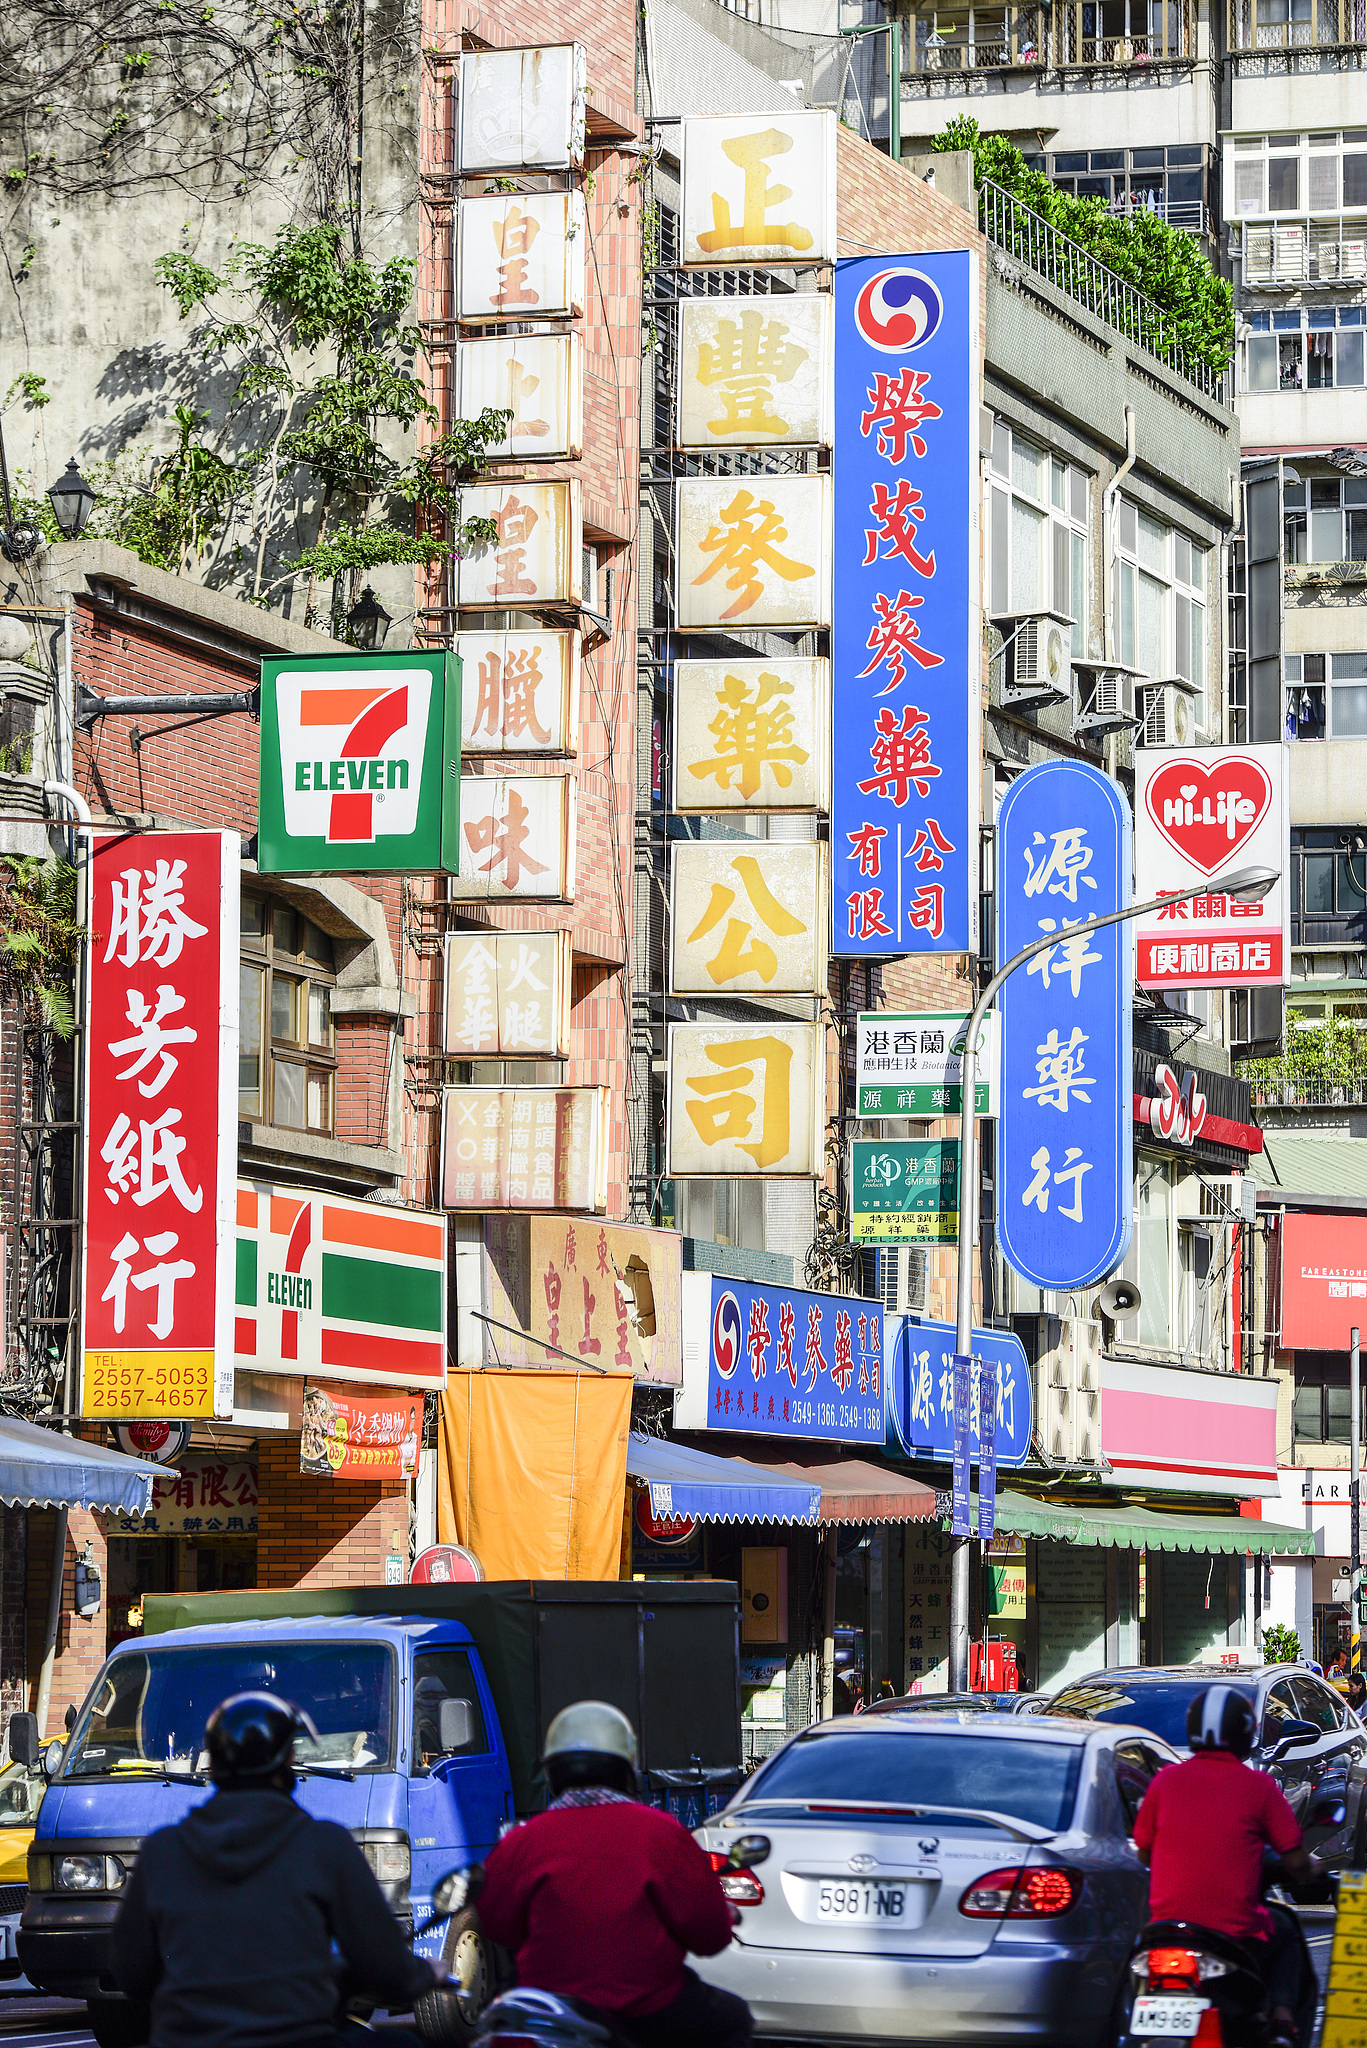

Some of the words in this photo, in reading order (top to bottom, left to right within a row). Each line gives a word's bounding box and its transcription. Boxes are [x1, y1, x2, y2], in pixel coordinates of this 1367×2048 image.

[1163, 785, 1256, 840] Hi-Life
[846, 821, 894, 941] 有限
[904, 819, 956, 940] 公司
[1150, 942, 1271, 974] 便利商店
[1022, 827, 1103, 1224] 源祥藥行
[865, 1030, 944, 1055] 港香蘭
[863, 1057, 917, 1071] 應用生技
[100, 858, 209, 1341] 勝芳紙行
[905, 1157, 955, 1174] 港香蘭
[564, 1224, 611, 1279] 廣東
[857, 1311, 881, 1352] 有限
[94, 1355, 122, 1367] TEL:
[93, 1368, 209, 1387] 2557-5053
[857, 1356, 882, 1401] 公司
[93, 1390, 208, 1408] 2557-4657
[137, 1452, 159, 1462] ATM
[388, 1567, 401, 1584] 343
